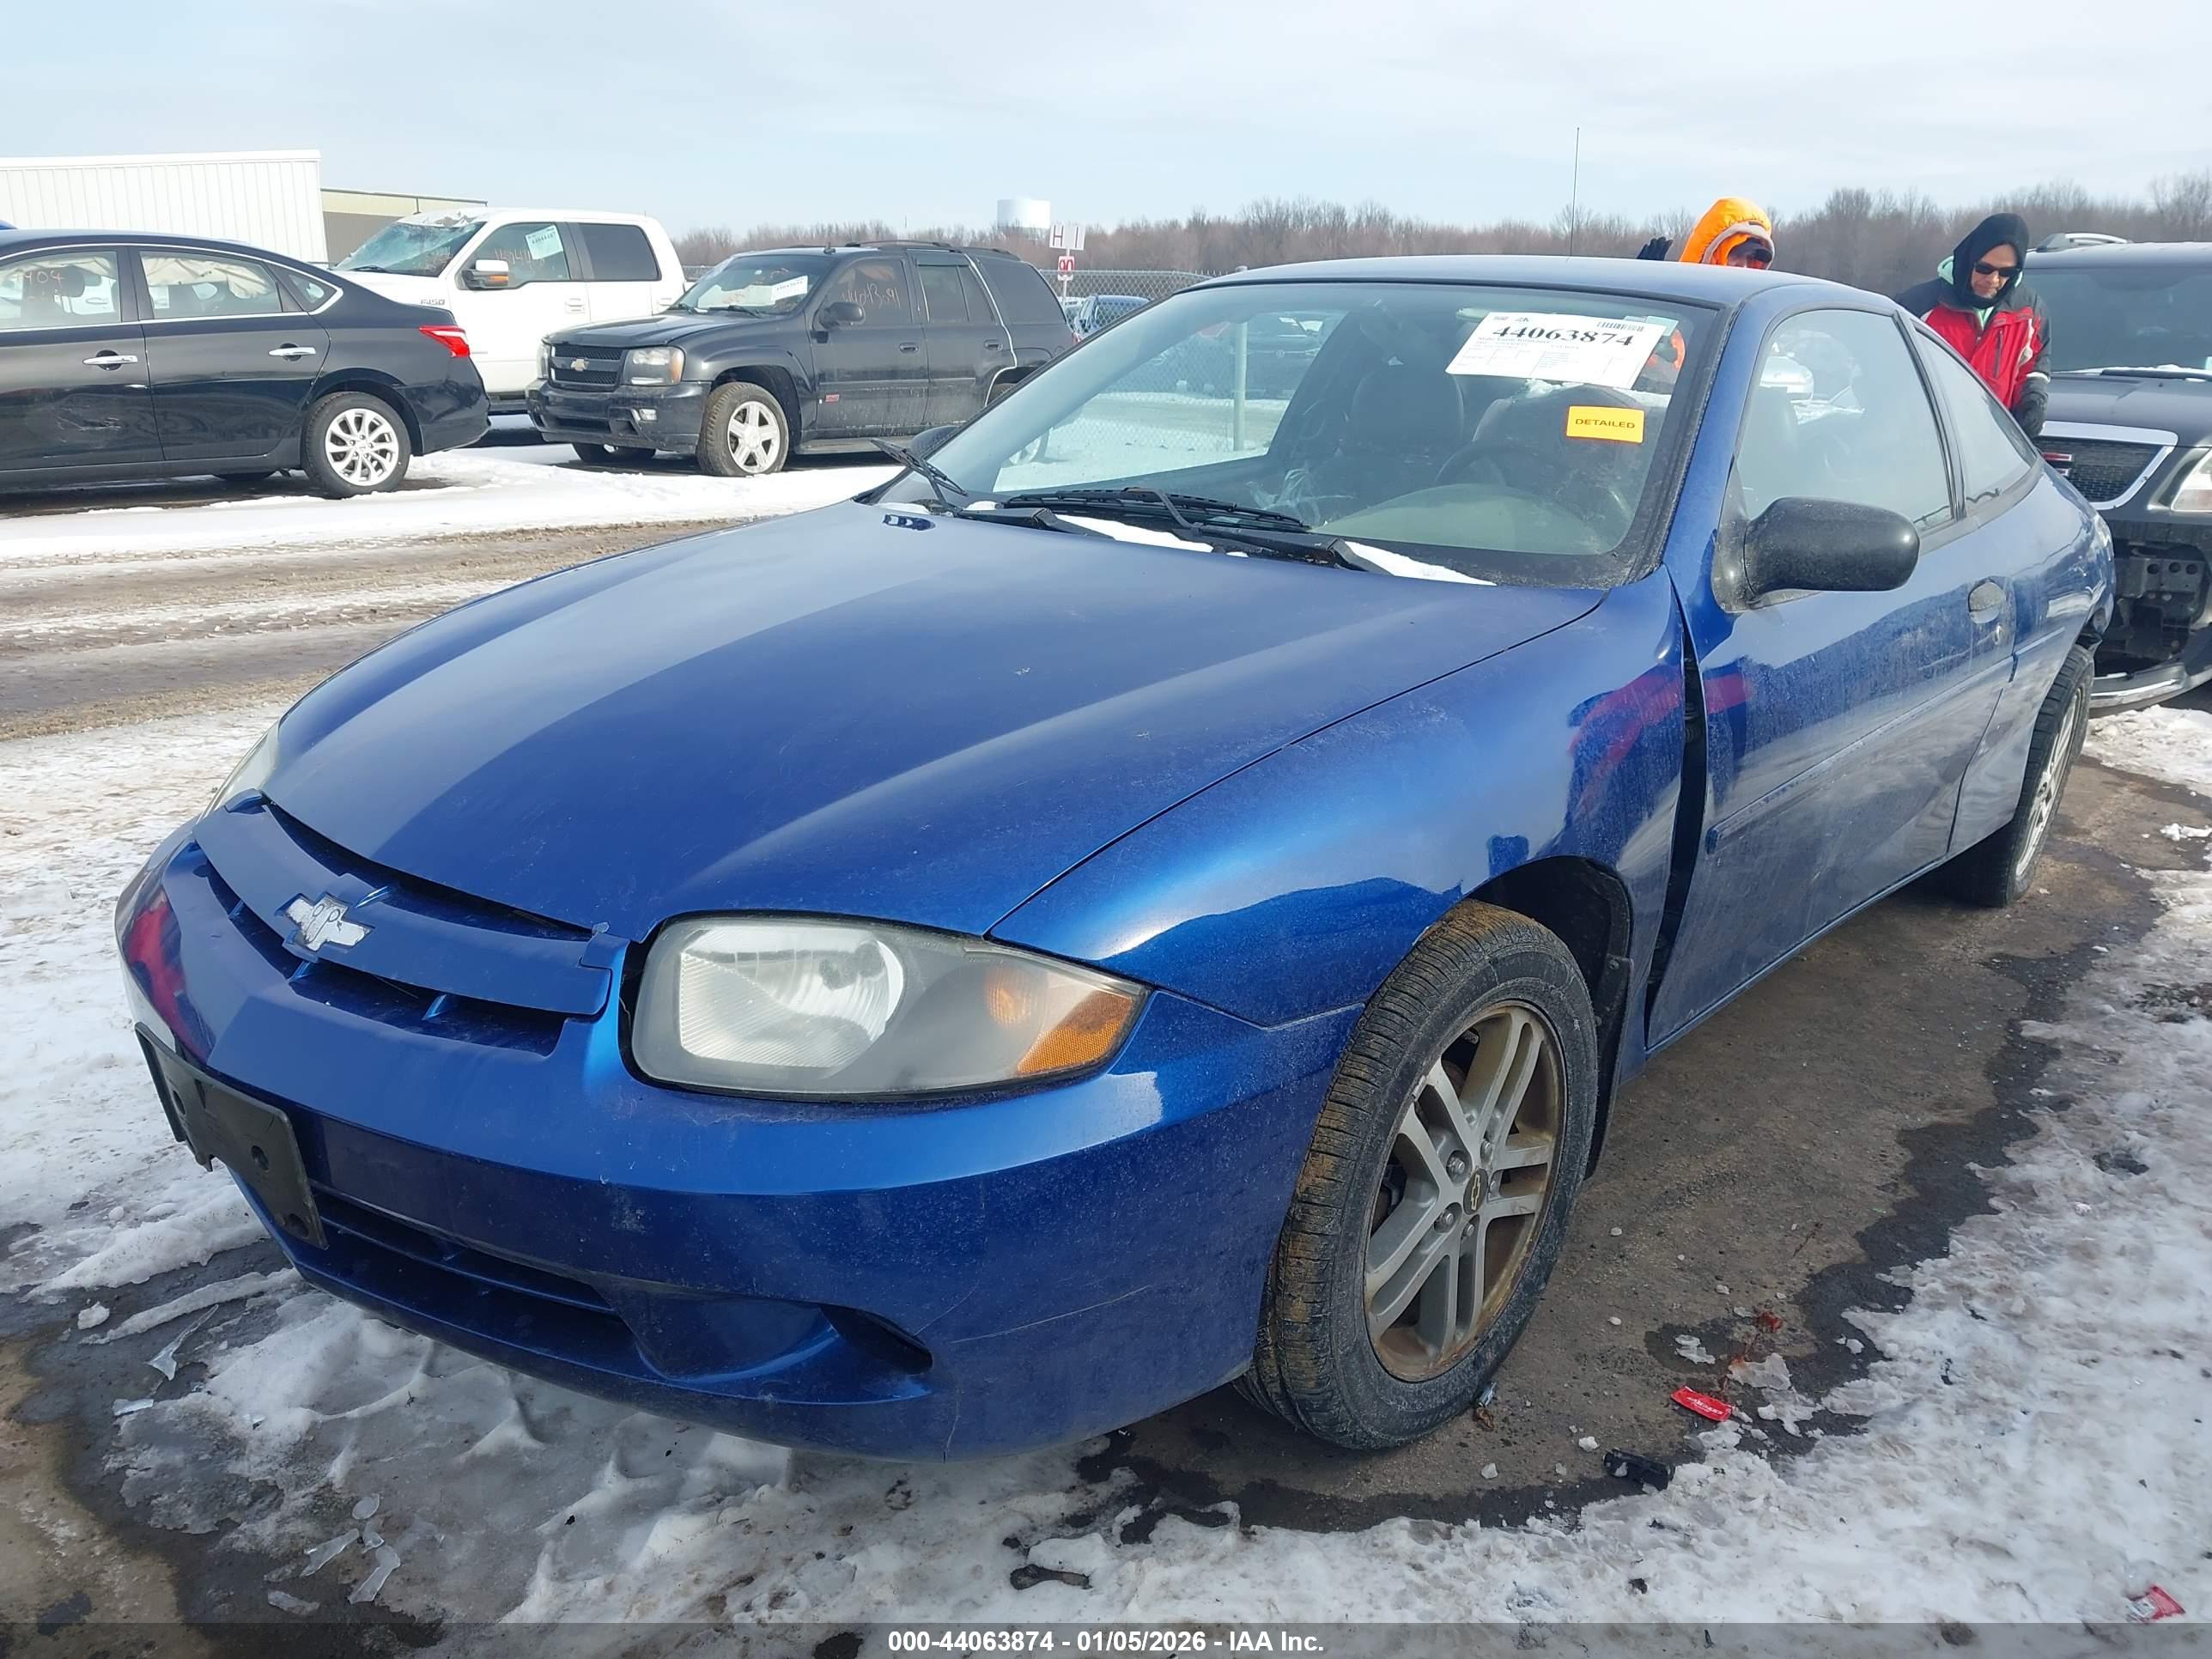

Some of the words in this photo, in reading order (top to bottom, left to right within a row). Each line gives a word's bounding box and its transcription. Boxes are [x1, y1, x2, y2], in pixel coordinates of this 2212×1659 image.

[1053, 225, 1064, 247] H
[1492, 325, 1634, 346] 44063874
[1575, 418, 1636, 428] DETAILED
